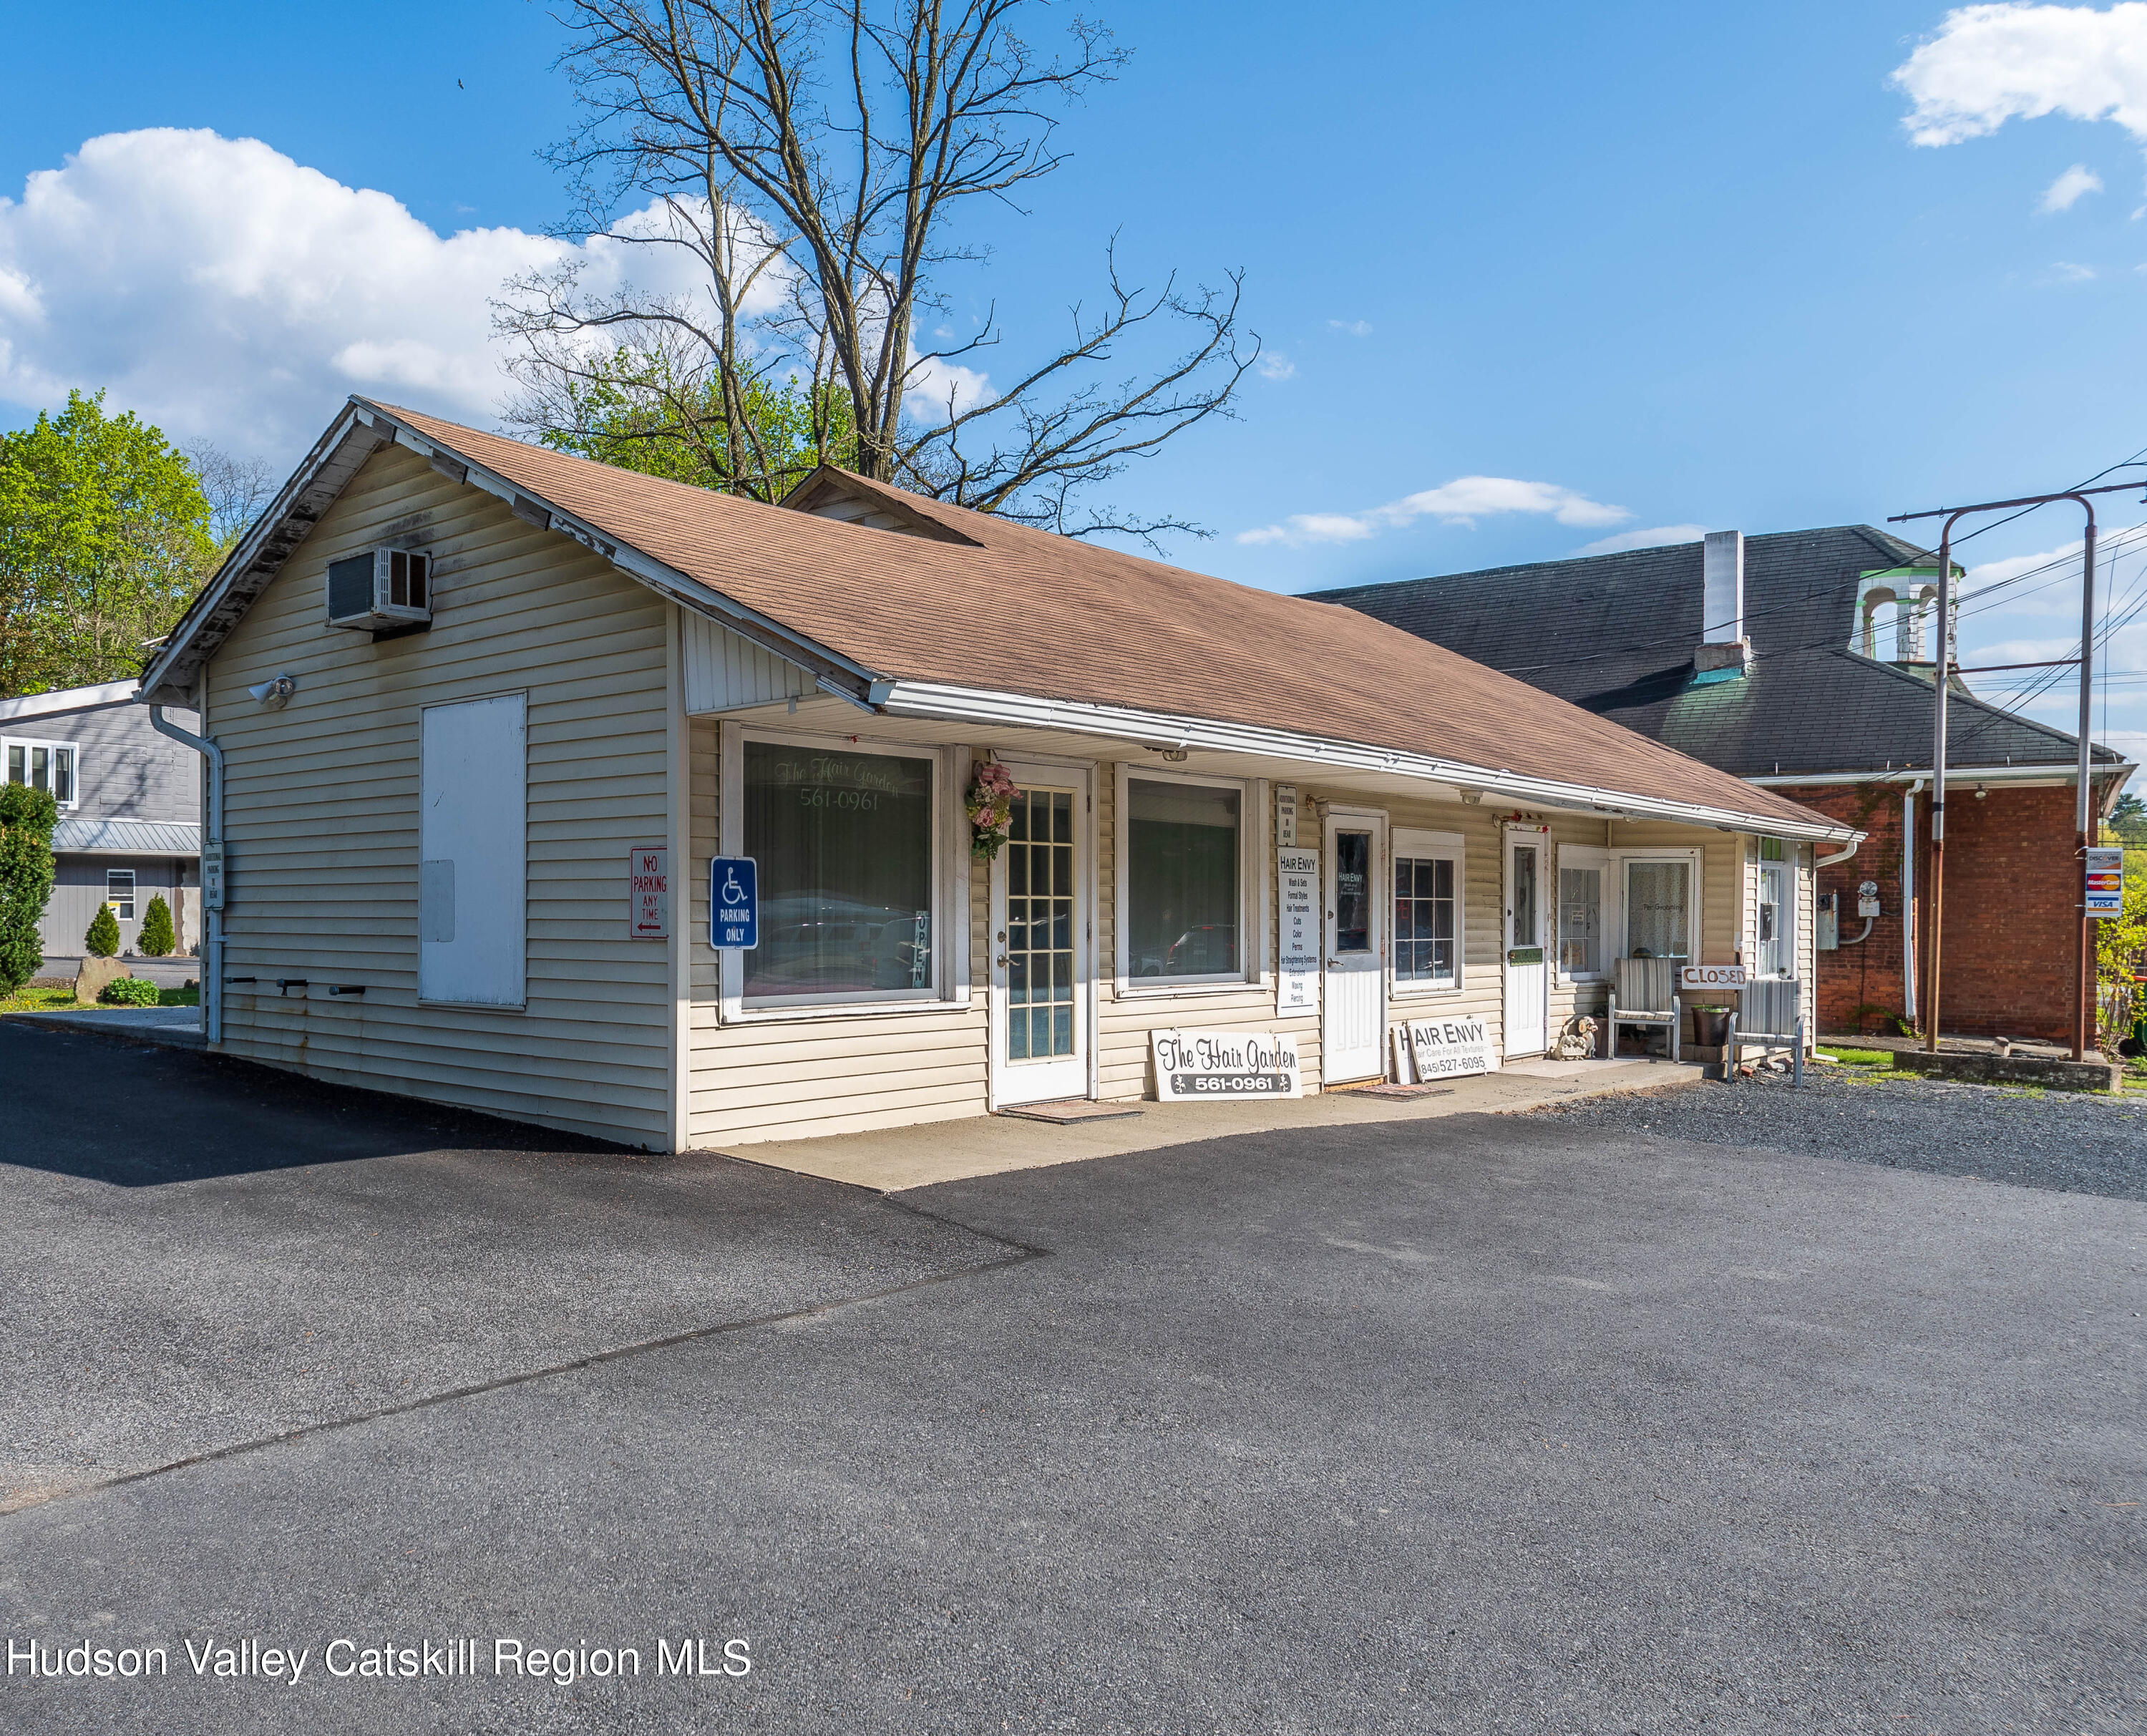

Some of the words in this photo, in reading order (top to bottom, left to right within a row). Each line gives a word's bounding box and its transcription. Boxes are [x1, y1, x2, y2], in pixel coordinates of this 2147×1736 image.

[775, 763, 806, 788] The
[812, 757, 849, 783] Hair
[854, 762, 899, 798] Garden
[801, 788, 877, 811] 561-0961
[643, 856, 658, 872] NO
[1280, 856, 1297, 869] HAIR
[1298, 857, 1315, 870] ENVY
[634, 875, 667, 892] PARKING
[1338, 872, 1350, 882] HAIR
[1350, 873, 1363, 882] ENVY
[643, 895, 658, 907] ANY
[1288, 891, 1298, 899] Formal
[1298, 891, 1308, 902] Styles
[642, 909, 658, 920] TIME
[720, 909, 749, 922] PARKING
[726, 928, 744, 942] ONLY
[1292, 930, 1302, 938] Color
[915, 915, 926, 981] OPEN
[1292, 942, 1303, 951] Perms
[1304, 955, 1317, 965] Systems
[1683, 968, 1746, 985] CLOSED
[1292, 981, 1303, 991] Waxing
[1443, 1023, 1484, 1044] ENVY
[1157, 1038, 1194, 1071] The
[1196, 1038, 1243, 1071] Hair
[1247, 1039, 1297, 1074] Garden
[1426, 1048, 1441, 1058] Care
[1442, 1047, 1452, 1055] For
[1194, 1077, 1273, 1091] 561-0961
